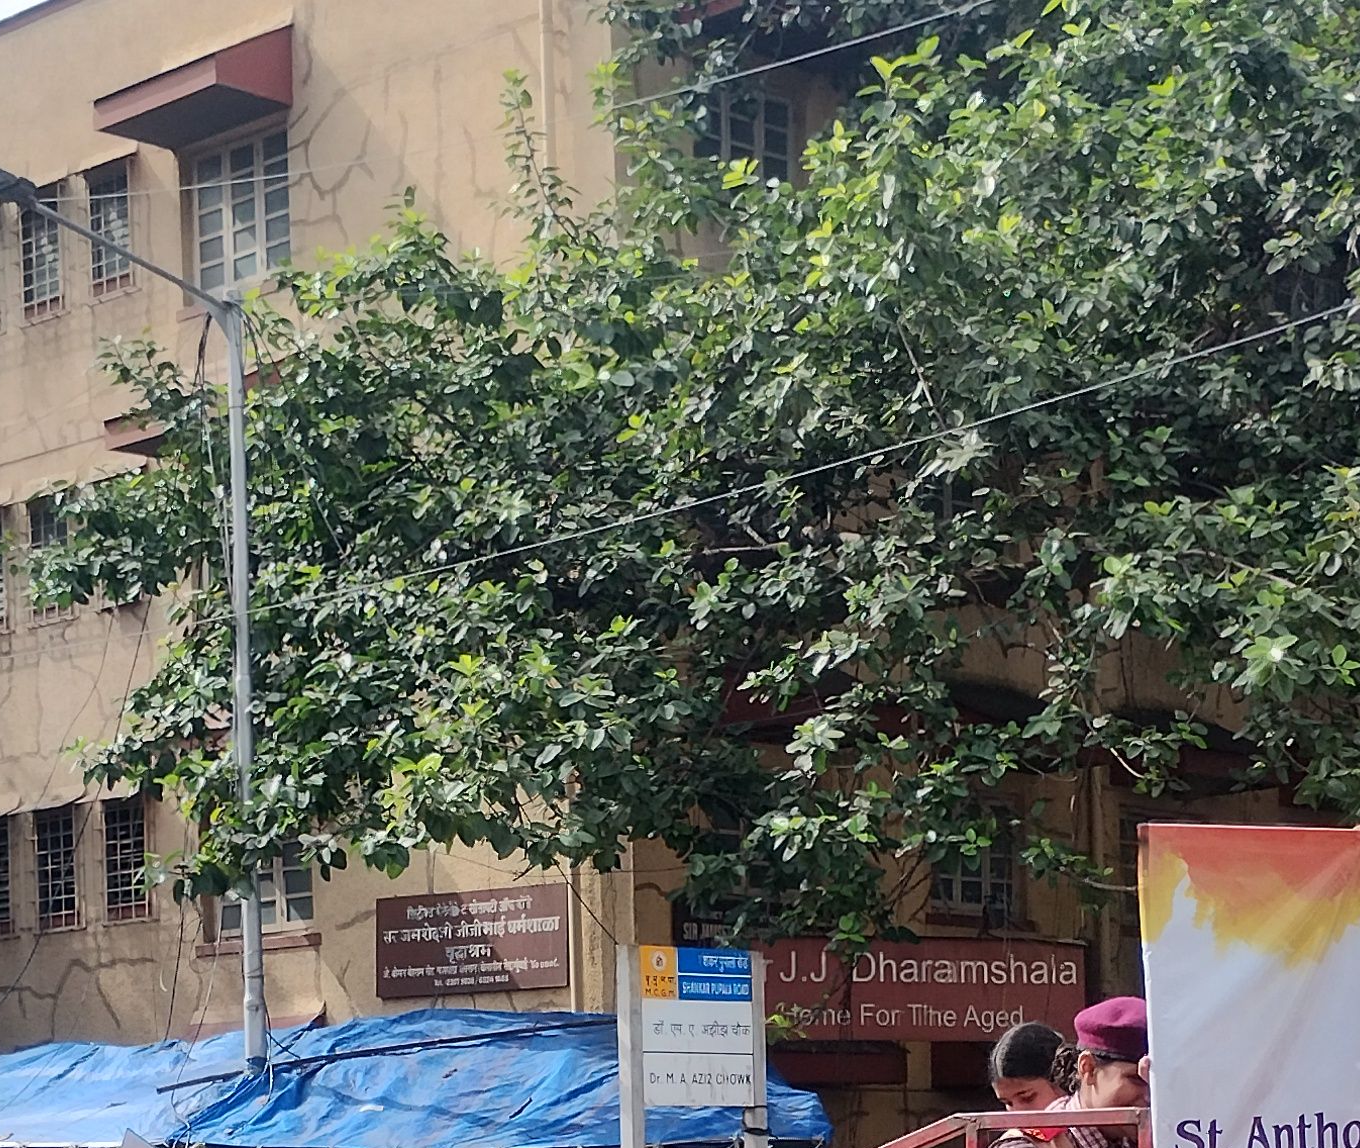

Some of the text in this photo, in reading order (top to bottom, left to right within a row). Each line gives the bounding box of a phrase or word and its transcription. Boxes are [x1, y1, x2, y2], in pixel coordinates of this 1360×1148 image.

[851, 950, 1077, 985] Dharamshala
[860, 1003, 900, 1026] For
[963, 1004, 1024, 1033] Aged
